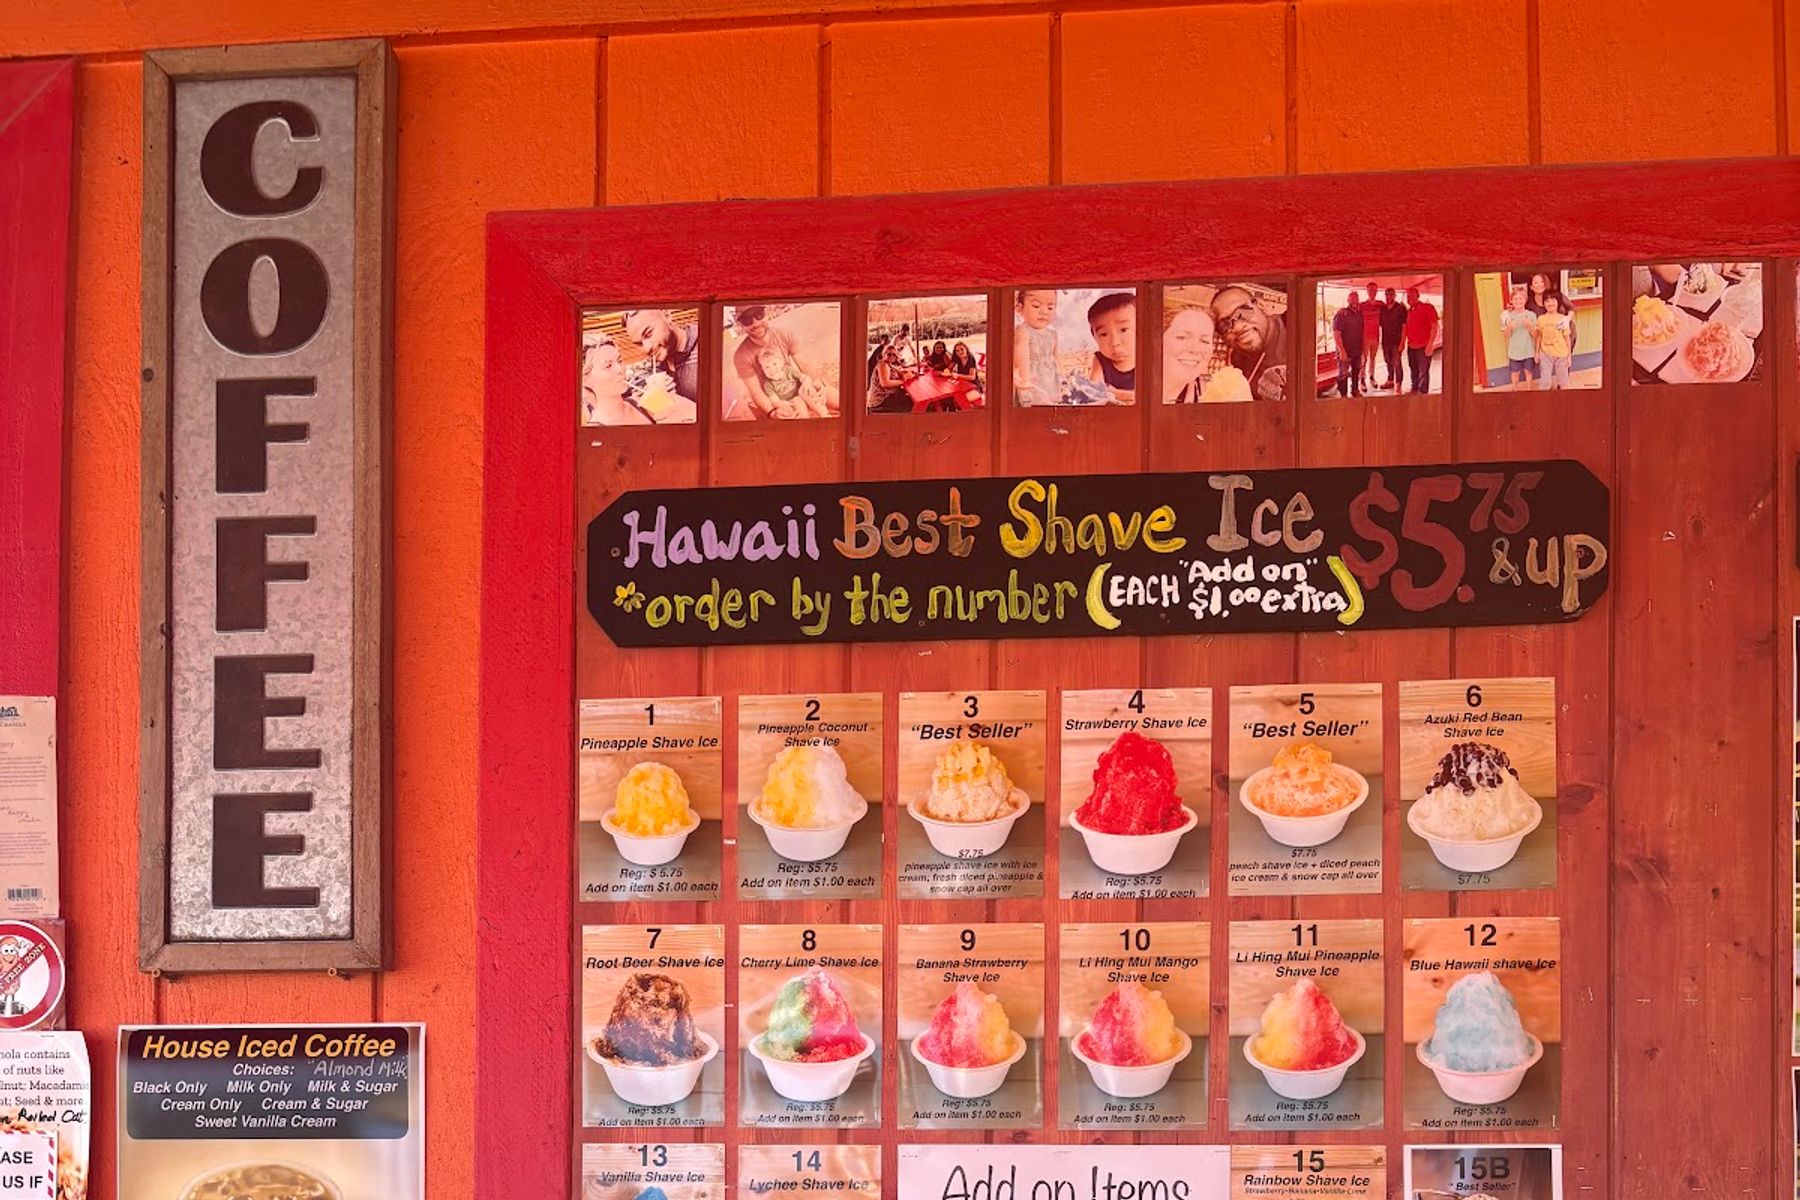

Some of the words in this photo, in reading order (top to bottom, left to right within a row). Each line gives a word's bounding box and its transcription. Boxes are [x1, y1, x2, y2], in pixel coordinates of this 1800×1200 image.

[200, 100, 332, 909] COFFEE
[623, 503, 820, 569] Hawaii
[832, 486, 981, 560] Best
[1000, 479, 1187, 559] Shave
[1206, 473, 1325, 554] Ice
[1490, 537, 1522, 585] &
[1526, 534, 1607, 613] up
[792, 576, 831, 635] by
[843, 572, 913, 625] the
[927, 569, 1078, 623] number
[1300, 693, 1315, 715] 5
[1466, 684, 1482, 708] 6
[645, 703, 654, 725] 1
[964, 695, 979, 717] 3
[1424, 713, 1459, 725] Azuki
[1463, 712, 1487, 723] Red
[1491, 712, 1522, 722] Bean
[1444, 727, 1482, 738] Shave
[1486, 726, 1504, 737] Ice
[581, 737, 649, 751] Pineapple
[652, 737, 694, 749] Shave
[698, 736, 718, 747] Ice
[646, 928, 662, 950] 7
[1119, 928, 1151, 951] 10
[1464, 924, 1497, 946] 12
[1079, 957, 1092, 968] Li
[1095, 957, 1125, 970] Hing
[1128, 957, 1151, 968] Mui
[1155, 956, 1198, 970] Mango
[1410, 959, 1441, 971] Blue
[1445, 959, 1490, 971] Hawaii
[1493, 959, 1532, 970] shave
[1536, 958, 1556, 970] Ice
[1107, 972, 1146, 983] Shave
[1150, 972, 1169, 983] Ice
[24, 1050, 71, 1060] contains
[142, 1035, 230, 1059] House
[237, 1035, 297, 1058] Iced
[304, 1033, 396, 1058] Coffee
[3, 1066, 14, 1075] of
[17, 1066, 41, 1075] nuts
[45, 1066, 64, 1075] like
[232, 1063, 295, 1076] Choices:
[133, 1081, 171, 1094] Black
[175, 1082, 207, 1096] Only
[226, 1081, 256, 1093] Milk
[259, 1081, 291, 1096] Only
[308, 1081, 336, 1093] Milk
[340, 1081, 350, 1092] &
[355, 1081, 399, 1095] Sugar
[195, 1115, 237, 1128] Sweet
[241, 1115, 286, 1128] Vanilla
[291, 1115, 336, 1128] Cream
[0, 1151, 33, 1164] ASE
[792, 1151, 822, 1172] 14
[1293, 1150, 1325, 1173] 15
[1454, 1156, 1511, 1179] 15B
[2, 1176, 24, 1188] US
[29, 1176, 43, 1188] IF
[749, 1178, 799, 1192] Lychee
[804, 1179, 845, 1191] Shave
[849, 1179, 869, 1190] Ice
[1244, 1174, 1302, 1187] Rainbow
[1307, 1174, 1347, 1186] Shave
[1351, 1175, 1370, 1186] Ice
